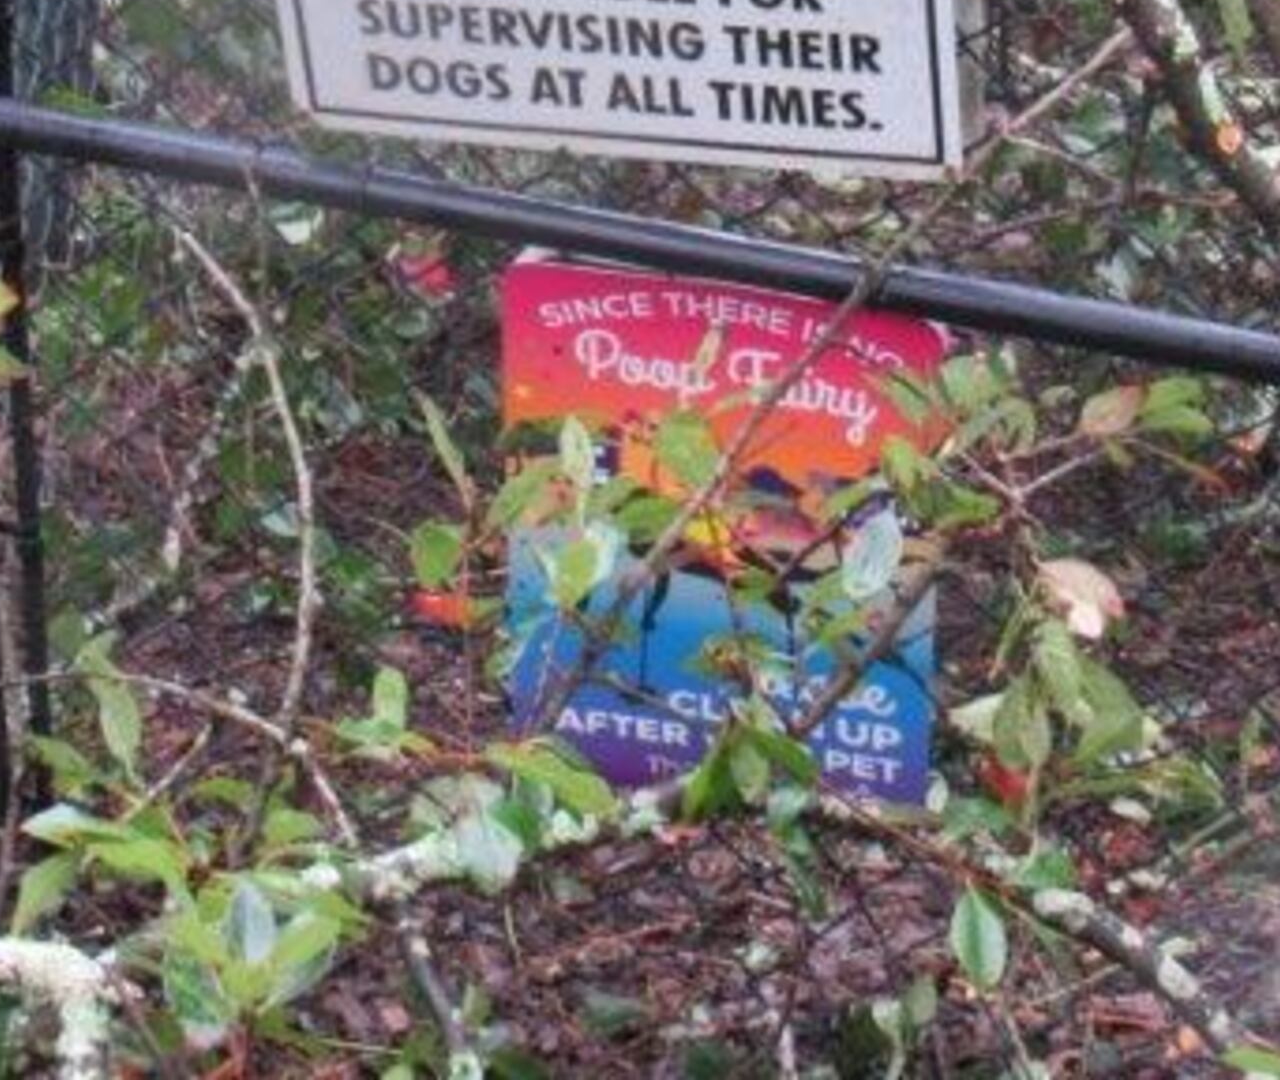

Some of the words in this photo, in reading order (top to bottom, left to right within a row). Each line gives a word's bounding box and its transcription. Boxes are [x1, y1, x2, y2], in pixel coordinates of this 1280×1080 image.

[724, 26, 880, 74] THEIR
[368, 54, 511, 101] DOGS
[530, 70, 588, 107] AT
[607, 75, 695, 117] ALL
[709, 80, 884, 132] TIMES.
[539, 292, 653, 329] SINCE
[663, 291, 793, 337] THERE
[555, 706, 689, 747] AFTER
[825, 749, 902, 783] PET
[835, 717, 902, 750] UP
